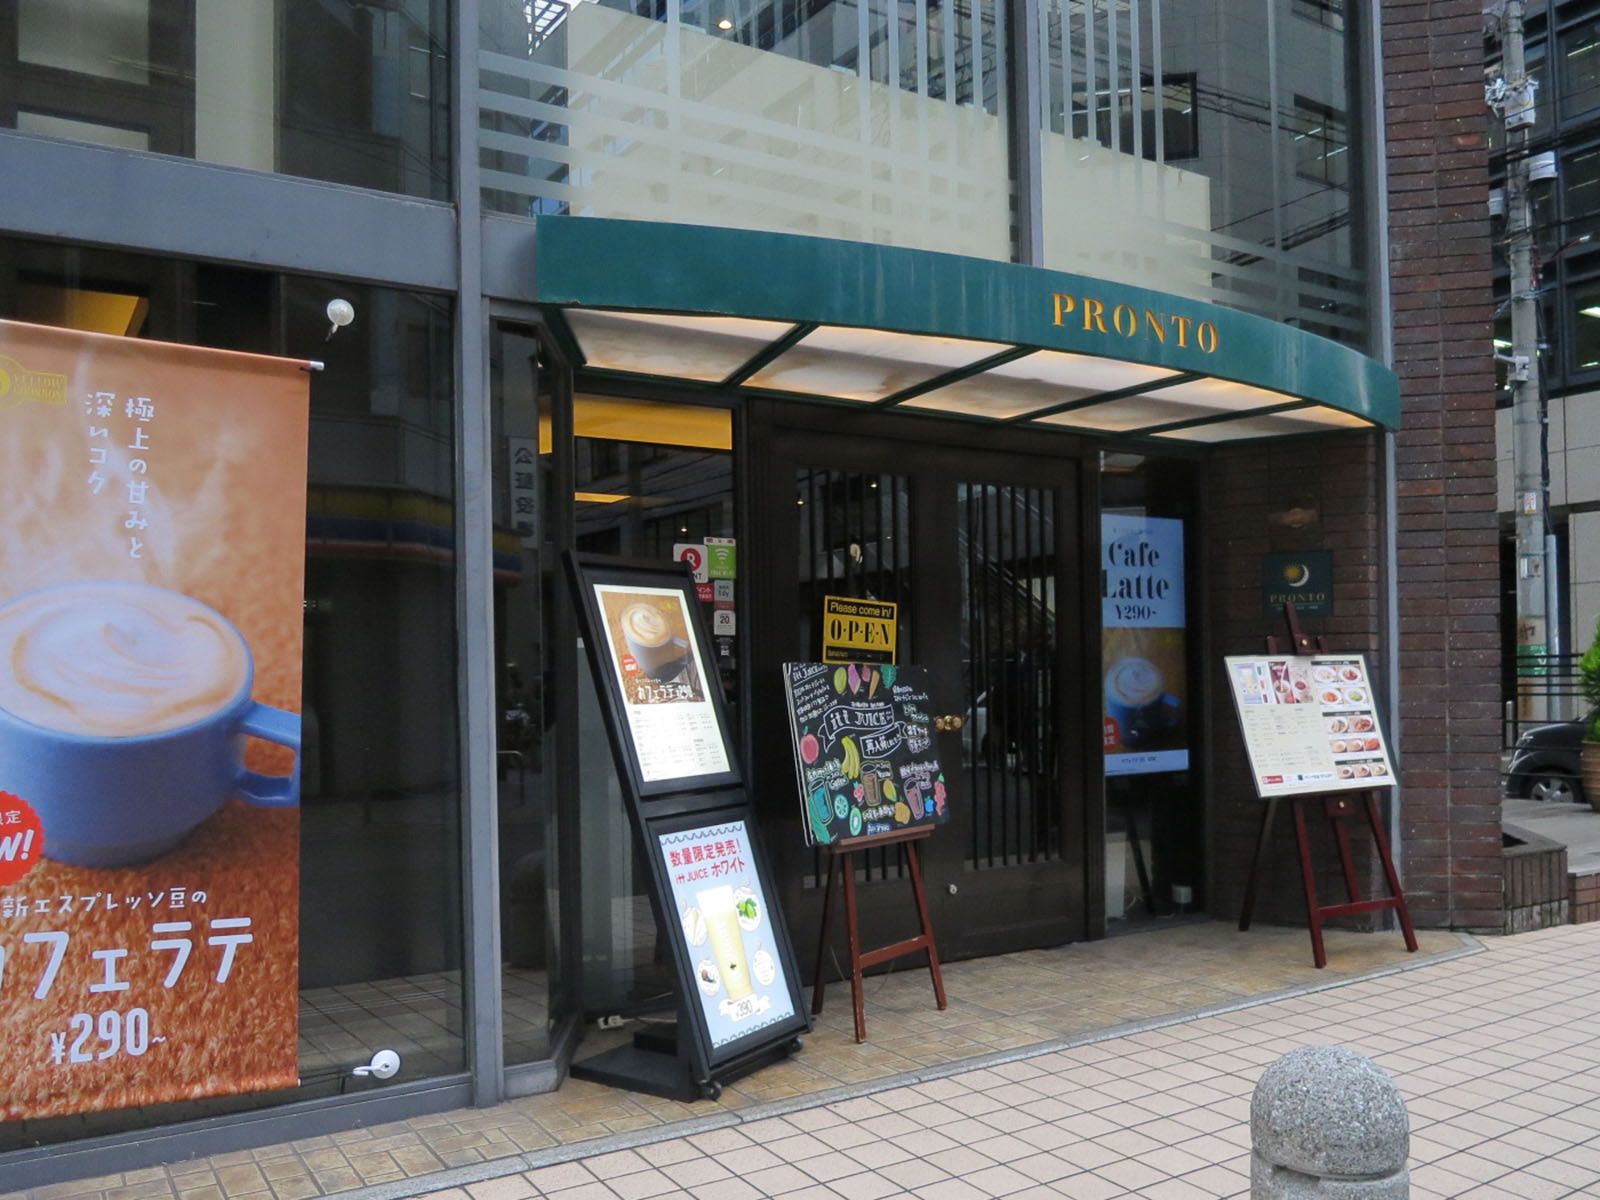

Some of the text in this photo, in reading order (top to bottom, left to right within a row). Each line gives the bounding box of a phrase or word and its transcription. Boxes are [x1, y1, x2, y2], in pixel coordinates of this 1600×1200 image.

[1052, 292, 1218, 353] PRONTO
[85, 391, 115, 494] 深いコク
[125, 397, 154, 559] 極上の甘みと
[1108, 540, 1160, 568] Cafe
[1103, 569, 1169, 600] Latte
[1269, 591, 1326, 604] PRONTO
[830, 601, 893, 618] Please come in!
[854, 711, 887, 727] JUICE
[0, 810, 22, 826] 定
[686, 867, 710, 882] JUICE
[710, 855, 745, 879] ホワイト
[2, 886, 207, 918] 新エスプレッソ豆の
[0, 917, 253, 1000] フェラテ
